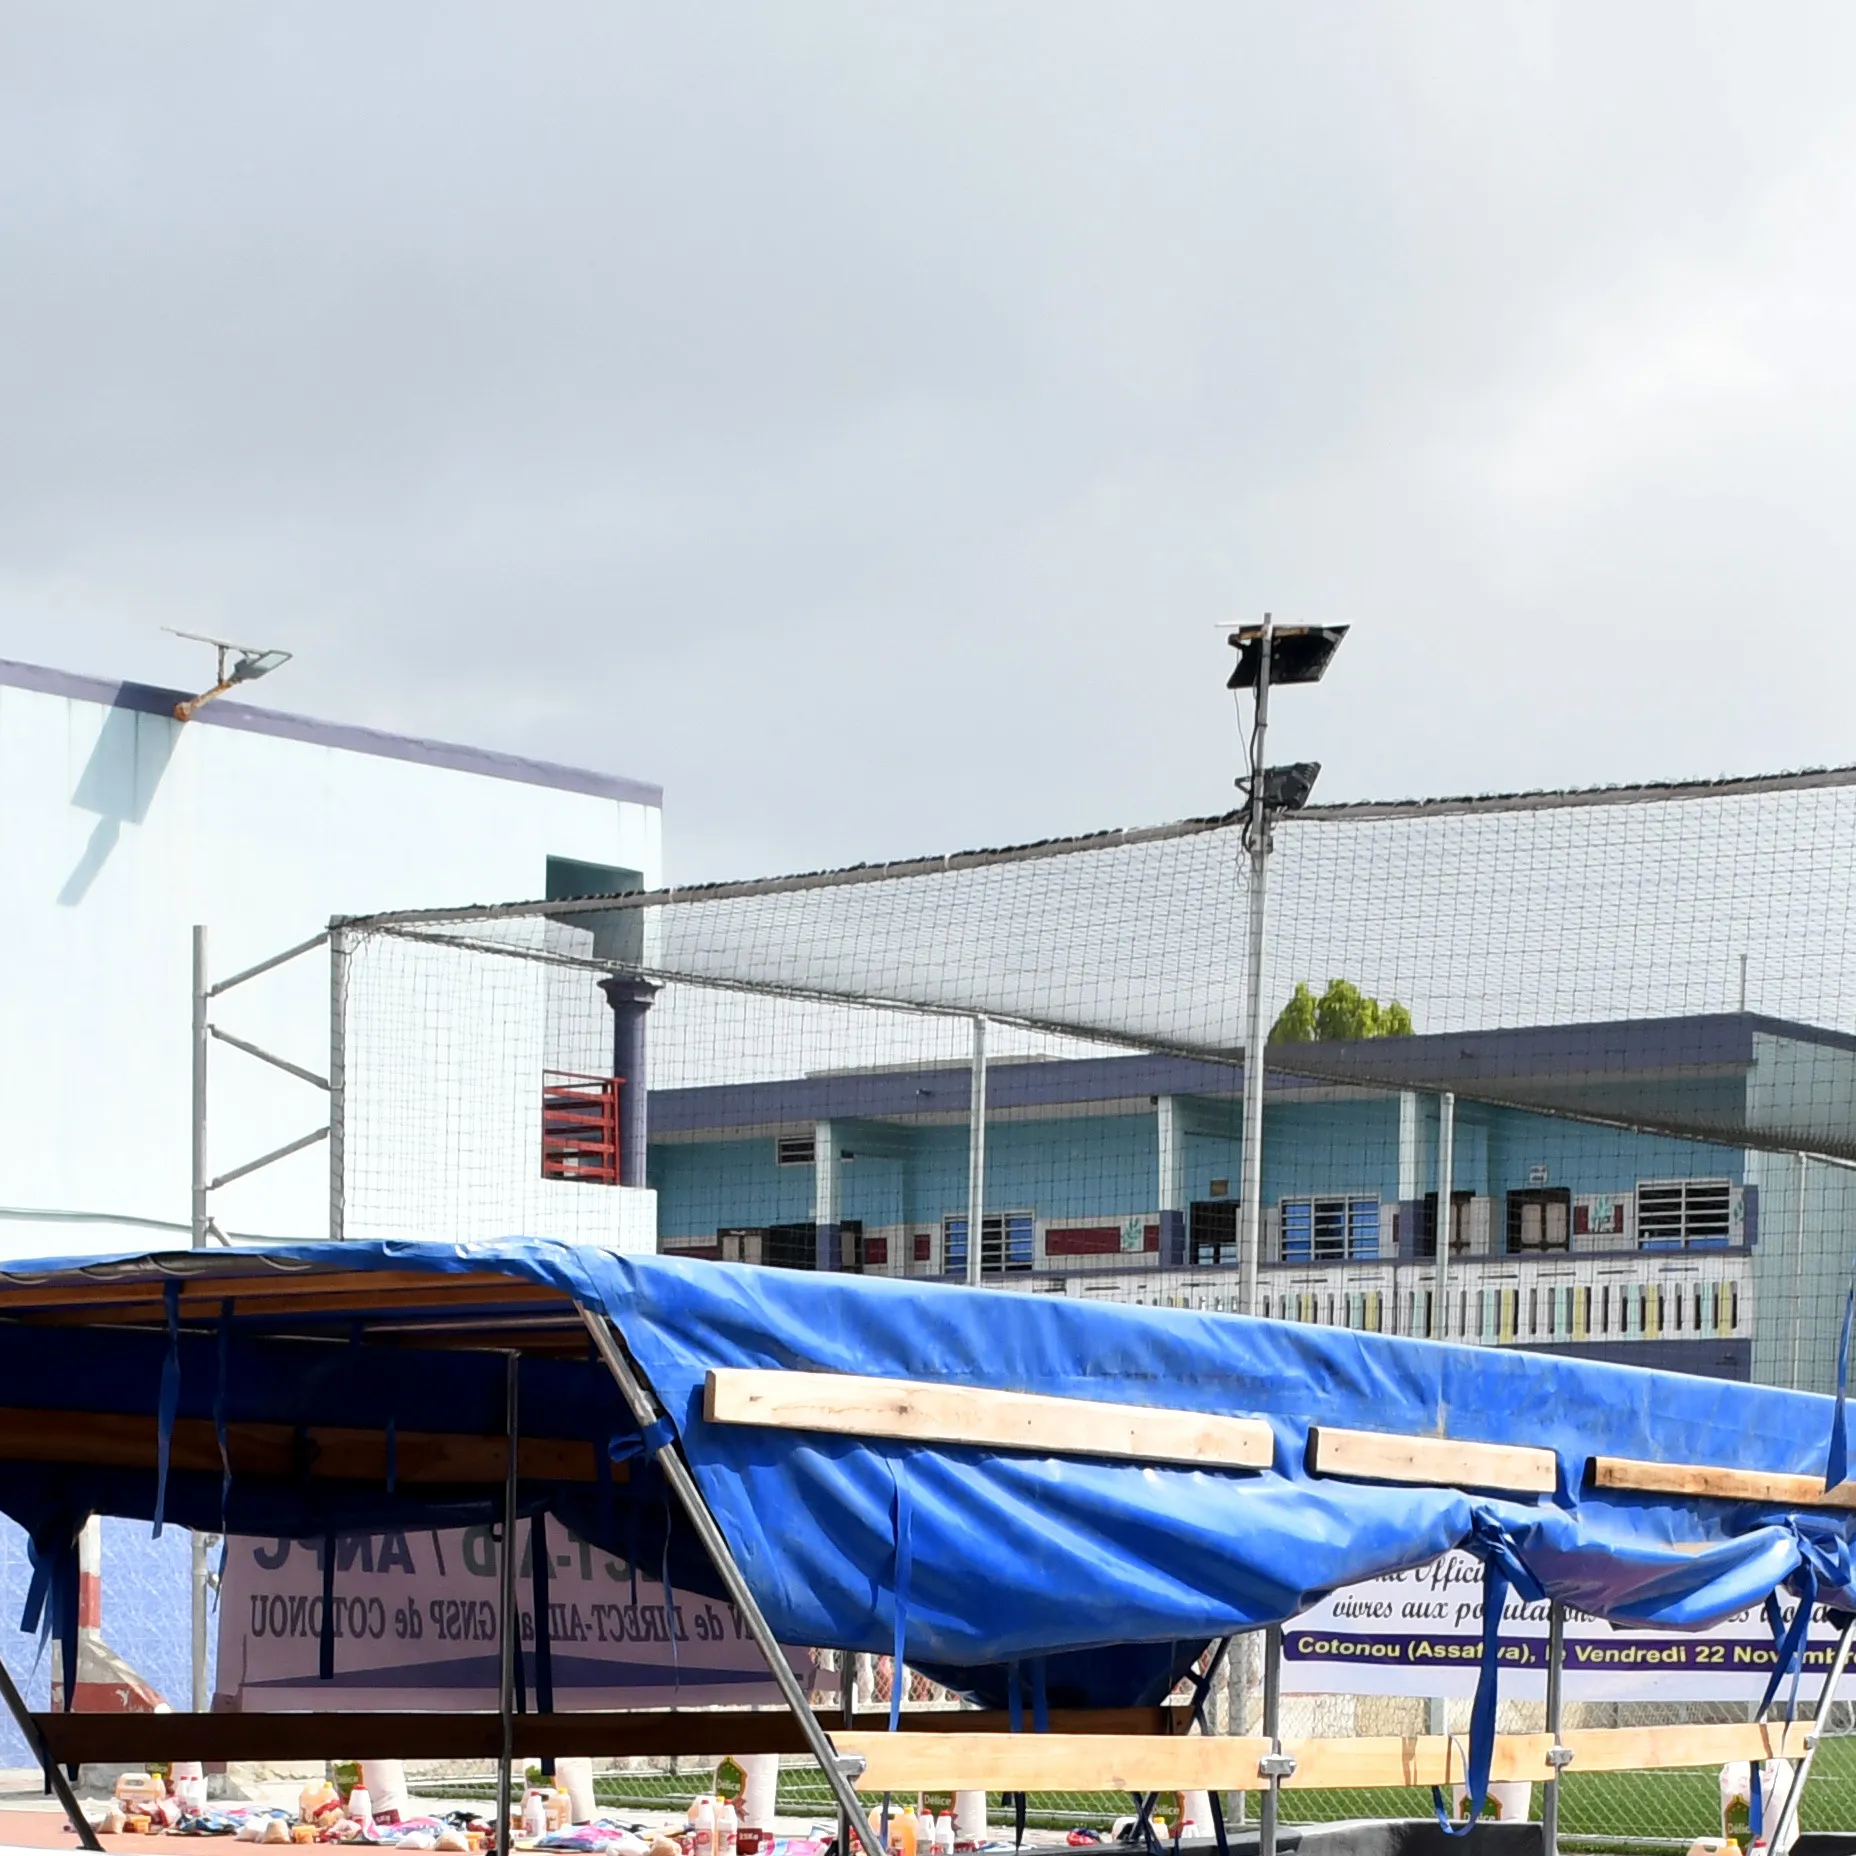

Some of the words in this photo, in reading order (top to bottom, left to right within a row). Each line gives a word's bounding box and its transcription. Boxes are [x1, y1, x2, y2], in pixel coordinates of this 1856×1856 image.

[1332, 1595, 1393, 1619] vivres
[1401, 1601, 1449, 1619] aux
[1298, 1636, 1400, 1658] Cotonou
[1575, 1645, 1687, 1663] Vendredi
[1695, 1646, 1725, 1663] 22
